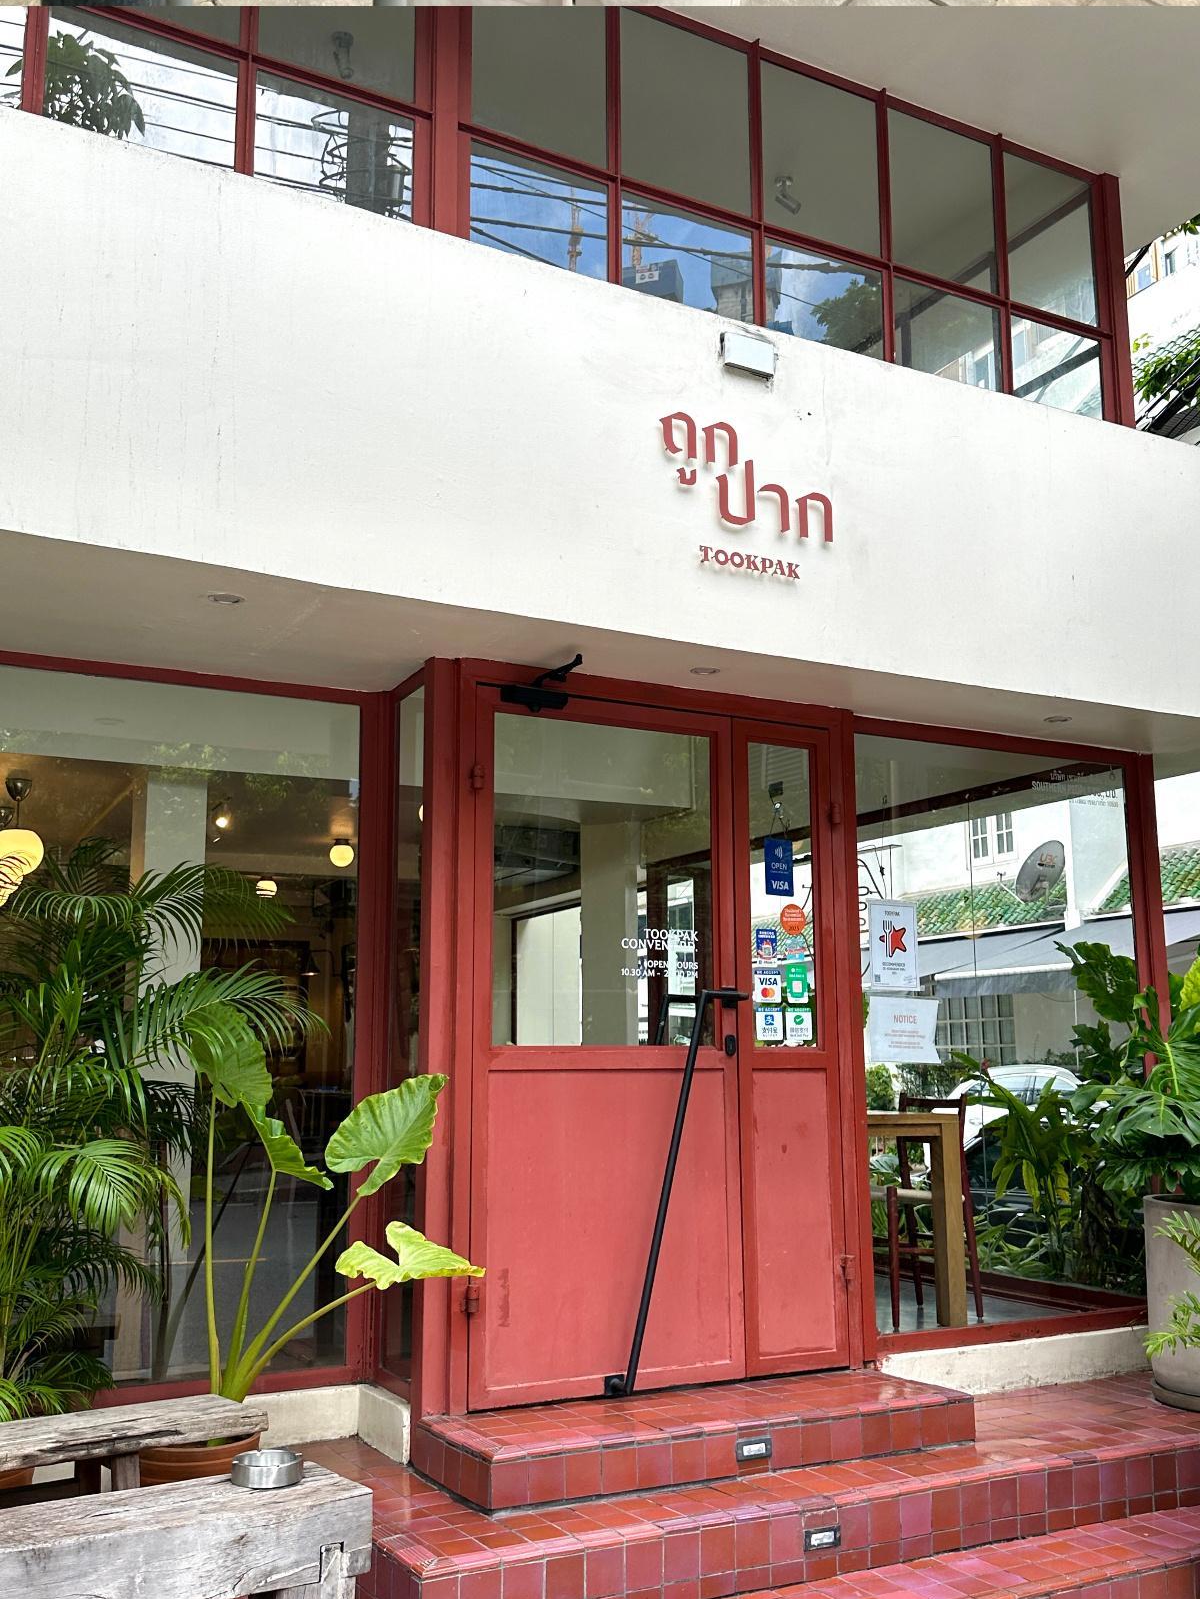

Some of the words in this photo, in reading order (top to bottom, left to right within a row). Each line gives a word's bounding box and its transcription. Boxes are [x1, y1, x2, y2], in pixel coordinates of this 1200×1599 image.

[699, 544, 800, 579] TOOKPAK
[771, 862, 788, 871] OPEN
[771, 879, 789, 890] VISA
[643, 928, 699, 942] TOOKPAK
[621, 937, 676, 952] CONVEN
[647, 960, 669, 969] OPEN
[670, 961, 699, 970] OURS
[758, 977, 778, 986] VISA
[893, 1014, 918, 1024] NOTICE
